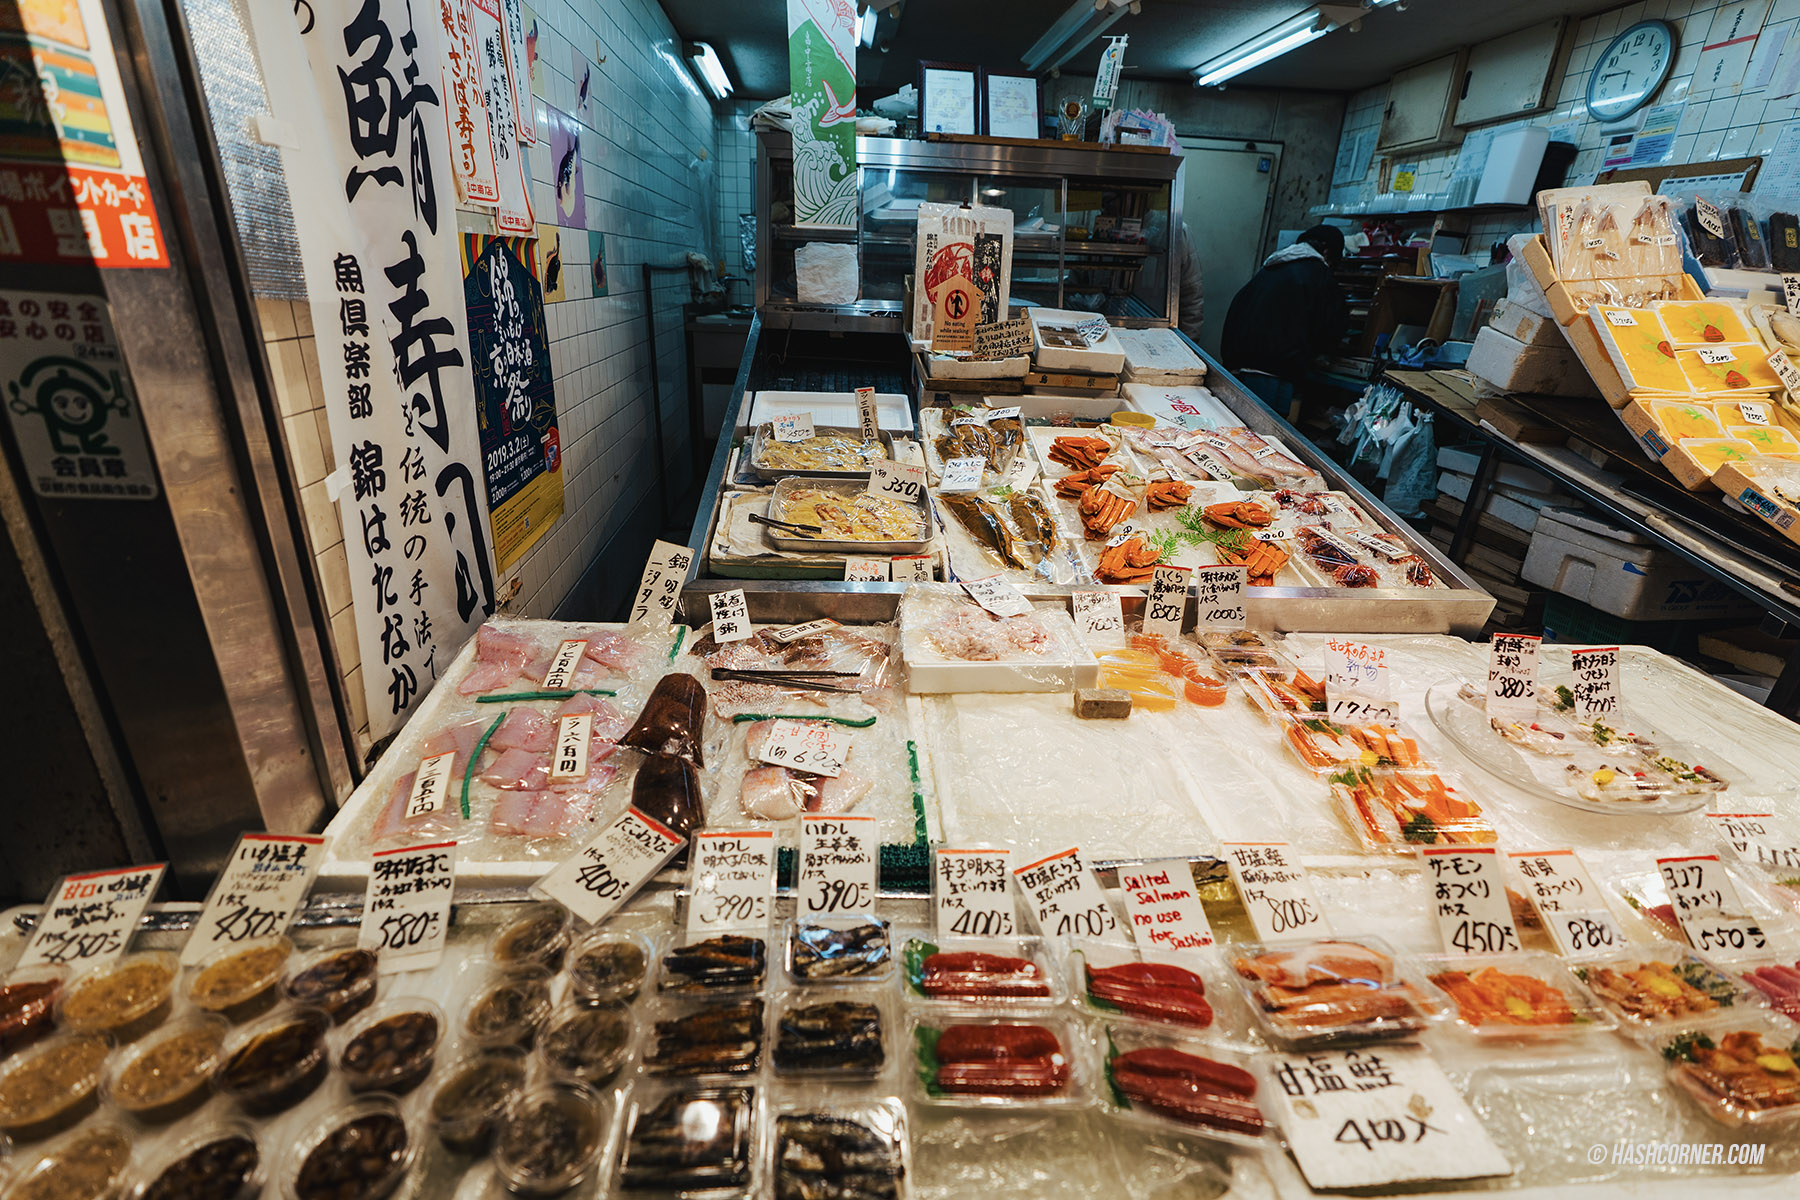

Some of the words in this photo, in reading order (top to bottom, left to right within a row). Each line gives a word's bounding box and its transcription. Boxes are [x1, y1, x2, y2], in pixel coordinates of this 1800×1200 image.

[1633, 33, 1645, 46] 12
[1620, 42, 1630, 53] 11
[1652, 45, 1662, 56] 2
[1607, 57, 1618, 69] 10
[1651, 60, 1660, 72] 3
[333, 252, 373, 419] 魚倶楽部
[350, 440, 417, 715] 錦はたなか
[1155, 570, 1182, 583] いくら
[1494, 638, 1524, 653] 新鮮
[805, 823, 848, 835] いわし
[702, 840, 749, 852] いわし
[704, 853, 768, 868] 明太子風味
[1429, 858, 1482, 877] サーモン
[1520, 858, 1558, 877] 赤貝
[940, 858, 1006, 880] 辛子明太子
[1436, 880, 1490, 899] おつくり
[1534, 877, 1583, 896] おつくり
[1134, 914, 1152, 926] no
[1158, 910, 1182, 922] use
[1148, 929, 1174, 944] for
